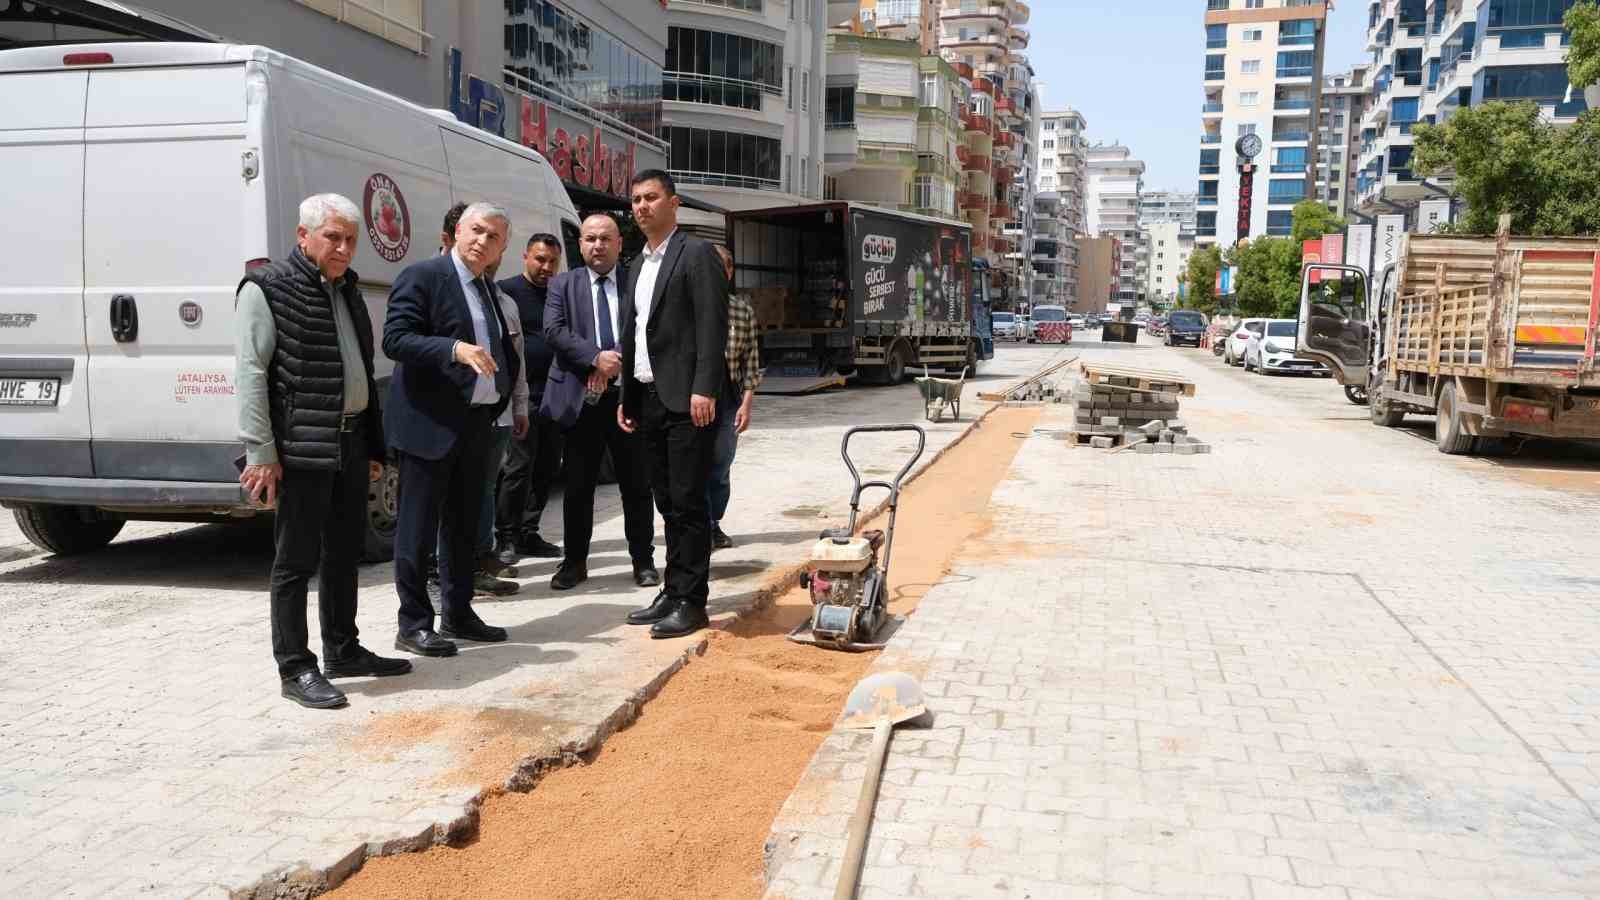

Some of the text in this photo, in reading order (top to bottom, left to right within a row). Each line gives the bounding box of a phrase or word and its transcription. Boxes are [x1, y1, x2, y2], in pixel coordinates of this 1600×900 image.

[1240, 176, 1250, 230] YEKTA
[864, 265, 886, 285] GÜCÜ
[869, 280, 896, 298] SERBEST
[0, 381, 53, 399] HVE 19
